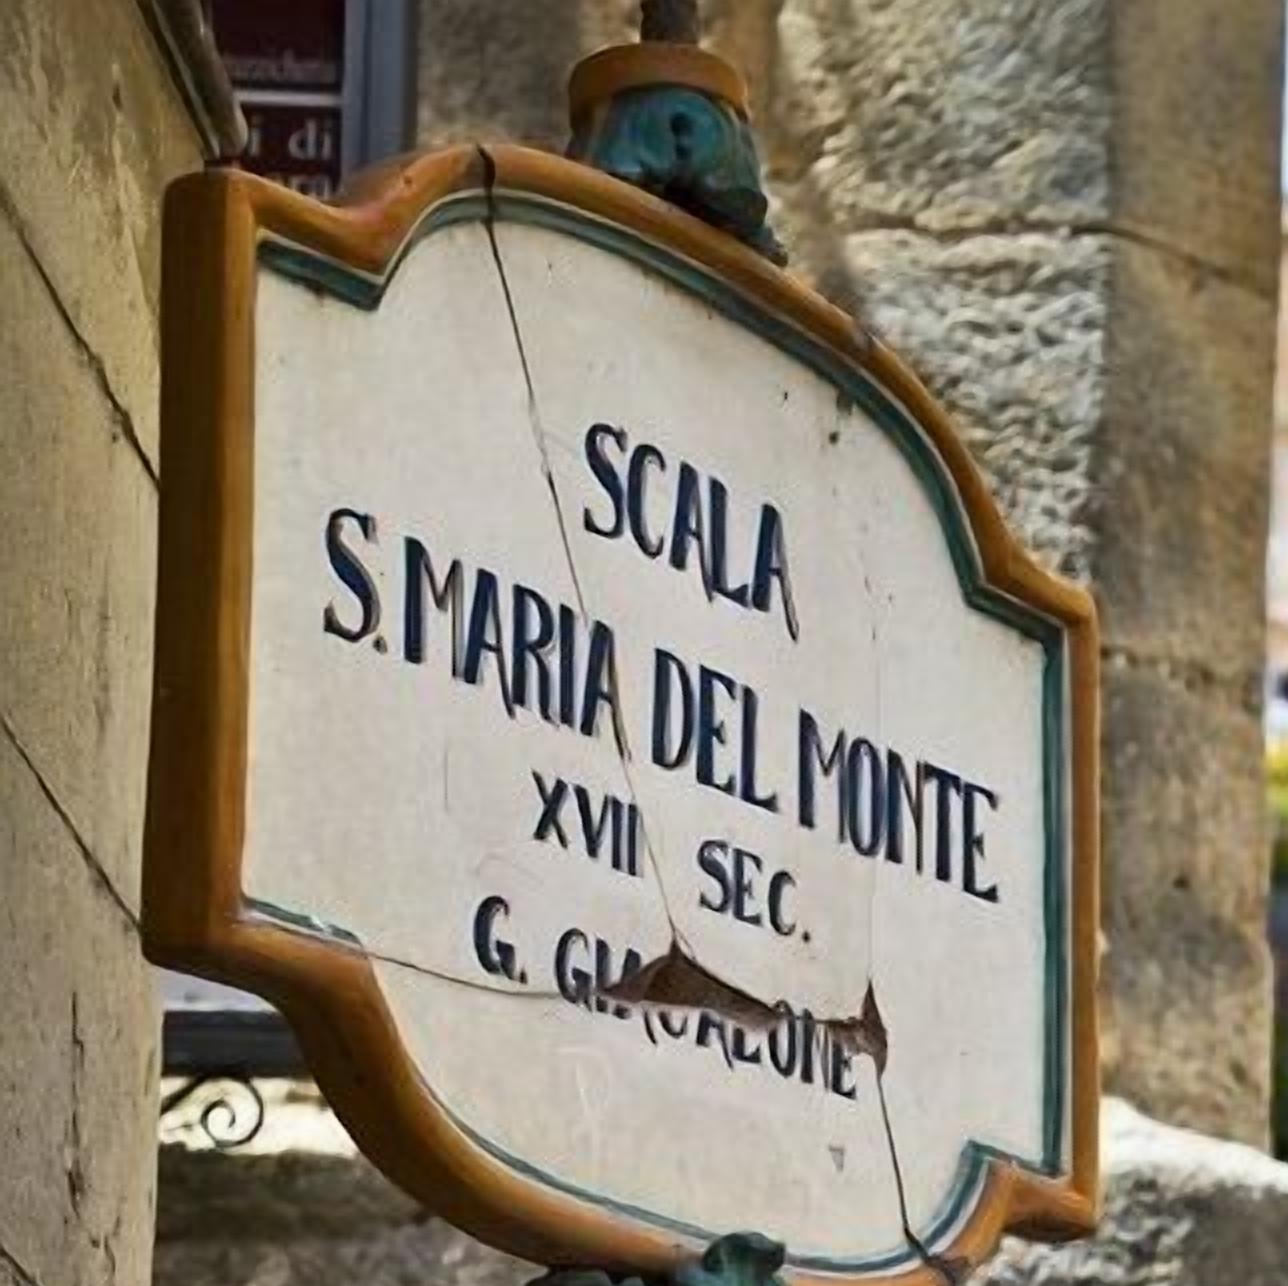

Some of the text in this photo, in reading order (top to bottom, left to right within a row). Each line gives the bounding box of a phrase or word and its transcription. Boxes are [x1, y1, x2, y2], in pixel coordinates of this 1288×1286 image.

[583, 422, 799, 641] SCALA
[323, 508, 1000, 904] S. MARIA DEL MONTE
[473, 895, 528, 984] G.
[531, 768, 812, 943] XVII SEC.
